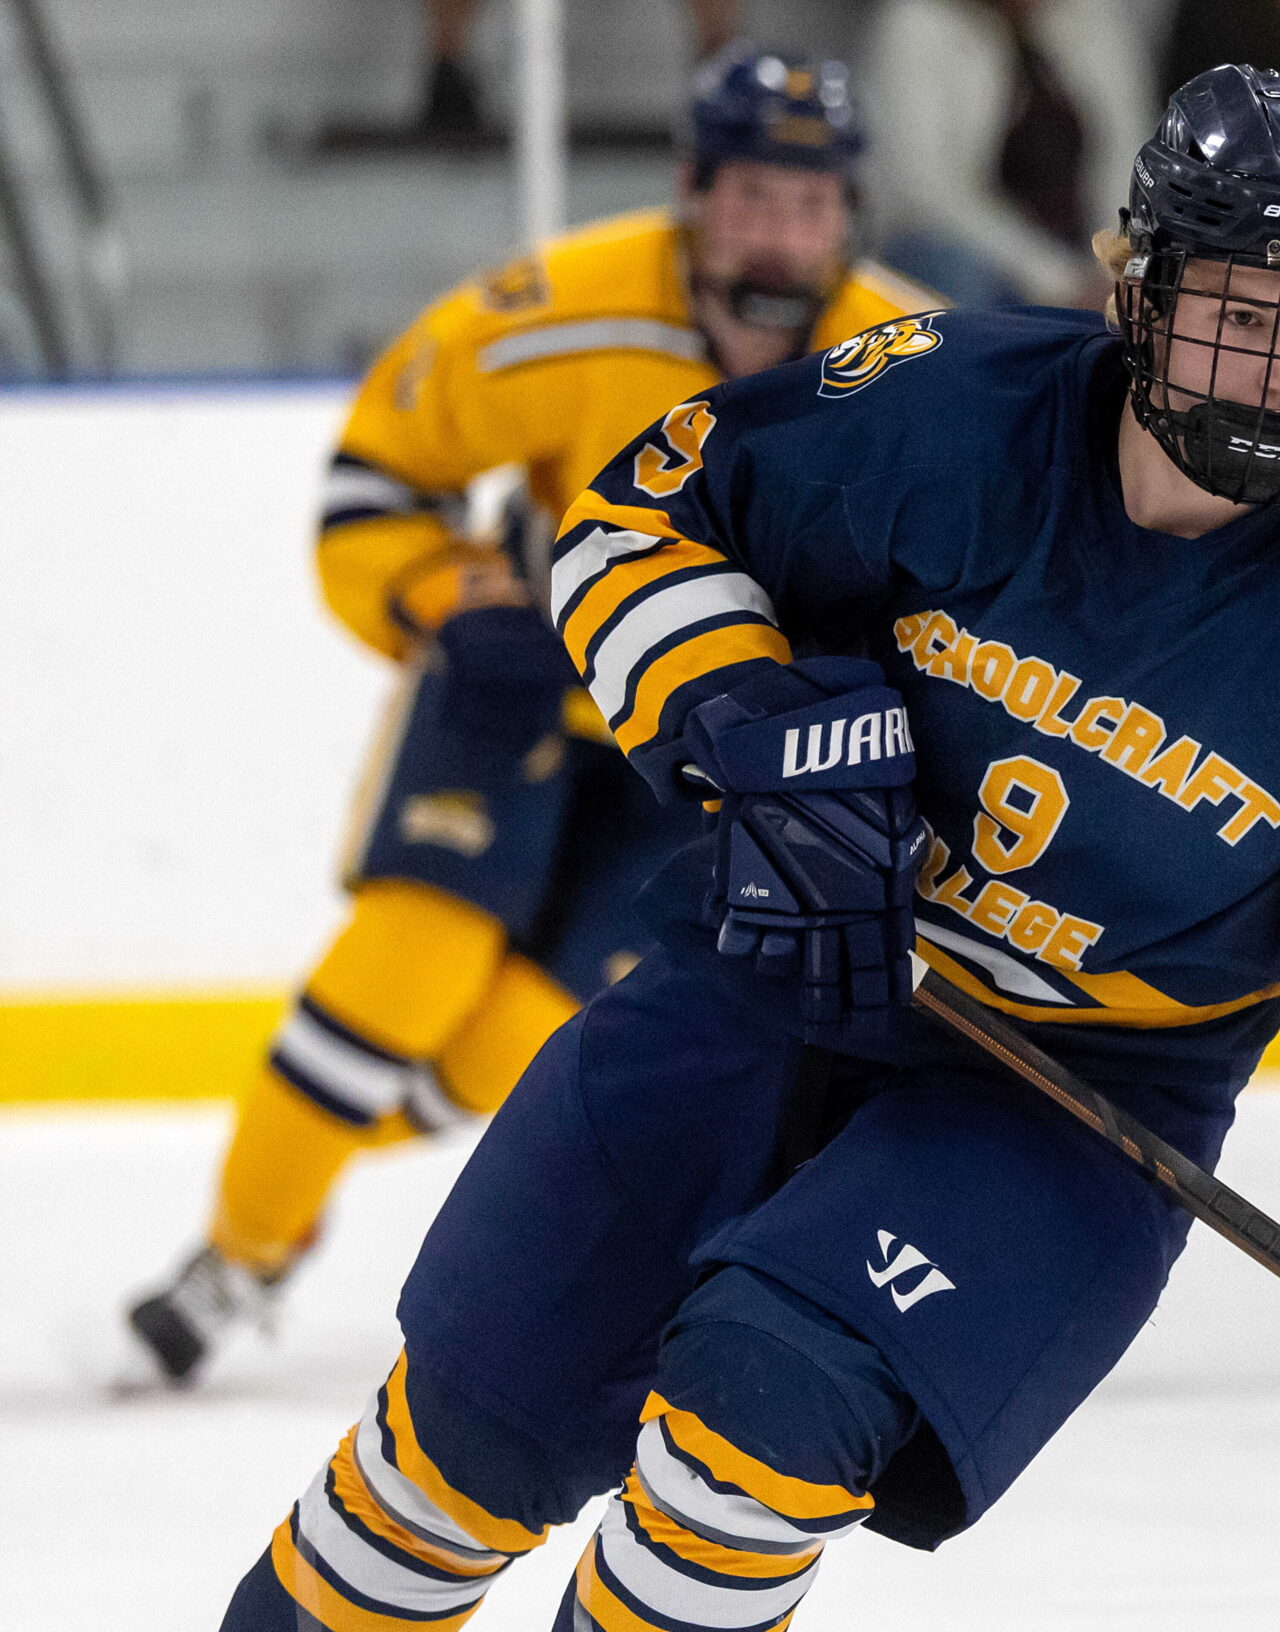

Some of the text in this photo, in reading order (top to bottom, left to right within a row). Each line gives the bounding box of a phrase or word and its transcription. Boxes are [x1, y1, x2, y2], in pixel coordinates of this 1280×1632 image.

[634, 400, 717, 499] 9
[971, 754, 1070, 875] 9
[915, 835, 1105, 973] LLEGE
